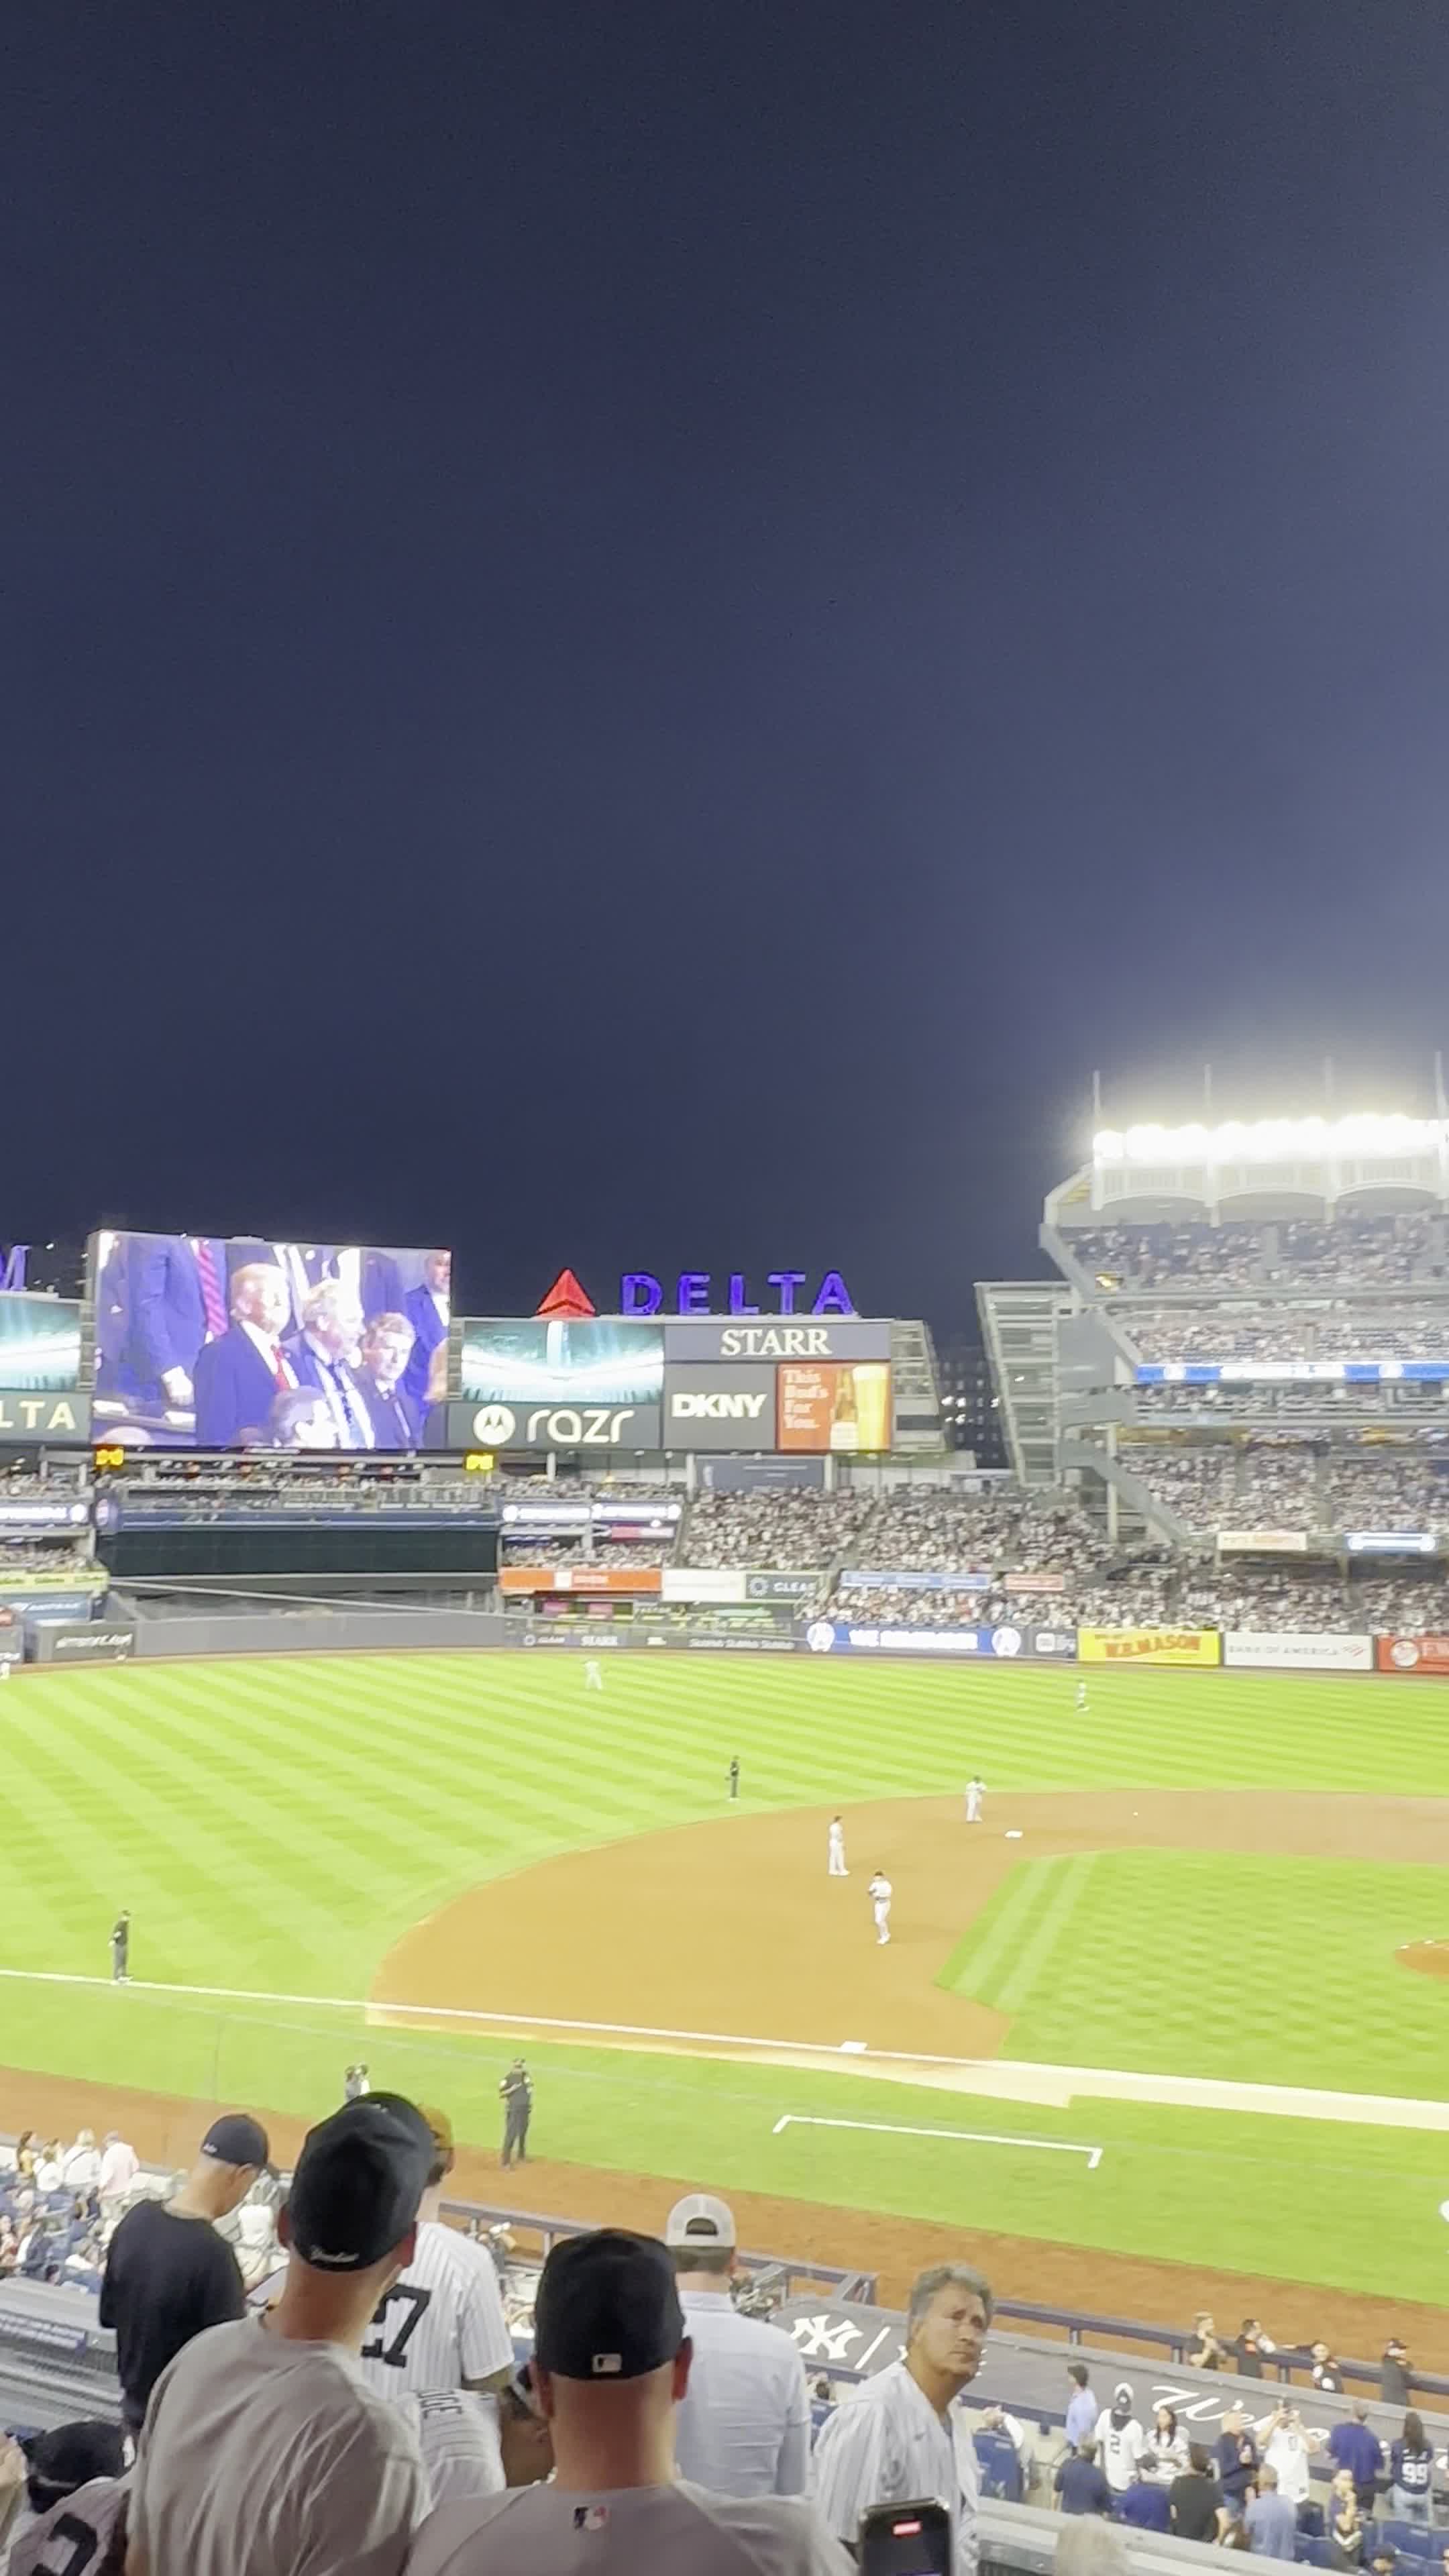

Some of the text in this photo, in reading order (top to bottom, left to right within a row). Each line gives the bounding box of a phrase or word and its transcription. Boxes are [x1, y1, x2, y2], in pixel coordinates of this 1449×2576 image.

[621, 1271, 857, 1316] DELTA
[720, 1328, 832, 1356] STARR
[672, 1393, 767, 1417] DKNY
[527, 1409, 635, 1442] razr
[1229, 1645, 1340, 1656] BANK OF AMERICA
[1401, 2462, 1428, 2485] 99
